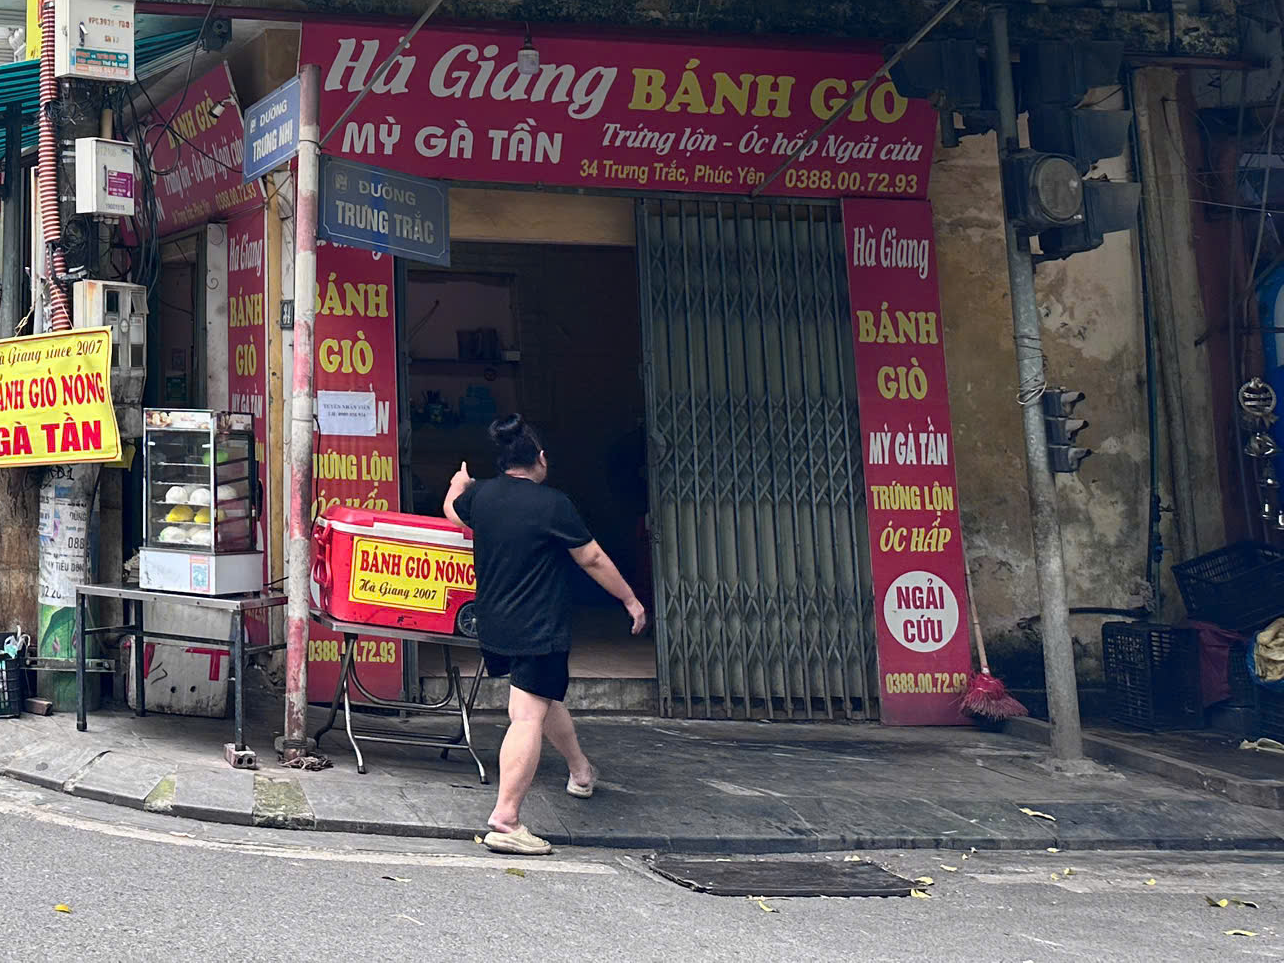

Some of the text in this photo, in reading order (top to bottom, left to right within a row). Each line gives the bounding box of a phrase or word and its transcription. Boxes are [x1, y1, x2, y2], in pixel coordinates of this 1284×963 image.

[324, 36, 416, 95] Hà
[429, 44, 618, 120] Giang
[628, 58, 796, 119] BÁNH
[341, 116, 563, 164] MỲ GÀ TẦN
[602, 123, 676, 156] Trứng
[679, 127, 718, 157] lộn
[821, 134, 879, 164] Ngải
[879, 136, 923, 162] cứu
[358, 180, 416, 206] ĐƯỜNG
[579, 158, 917, 193] 34 Trưng Trắc, Phúc Yên 0388.00.72.93
[335, 200, 389, 234] TRƯNG
[229, 232, 263, 277] Hà Giang
[853, 225, 930, 280] Hà Giang
[229, 286, 264, 328] BÁNH
[856, 301, 939, 344] BÁNH
[7, 346, 42, 368] Giang
[45, 344, 72, 359] since
[76, 339, 104, 356] 2007
[236, 334, 257, 376] GIÒ
[319, 330, 374, 375] GIÒ
[29, 368, 57, 409] GIÒ
[60, 365, 105, 406] NÓNG
[877, 357, 928, 400] GIÒ
[41, 412, 103, 453] TẦN
[869, 416, 948, 465] MỲ GÀ TẦN
[312, 449, 393, 486] RỨNG LỘN
[870, 481, 954, 516] TRỨNG LỘN
[879, 517, 952, 553] ÓC HẤP
[359, 545, 476, 586] BÁNH GIÒ NÓNG
[359, 578, 437, 601] Hà Giang 2007
[896, 578, 945, 610] NGẢI
[903, 614, 943, 644] CỨU
[885, 672, 968, 694] 0388.00.72.93
